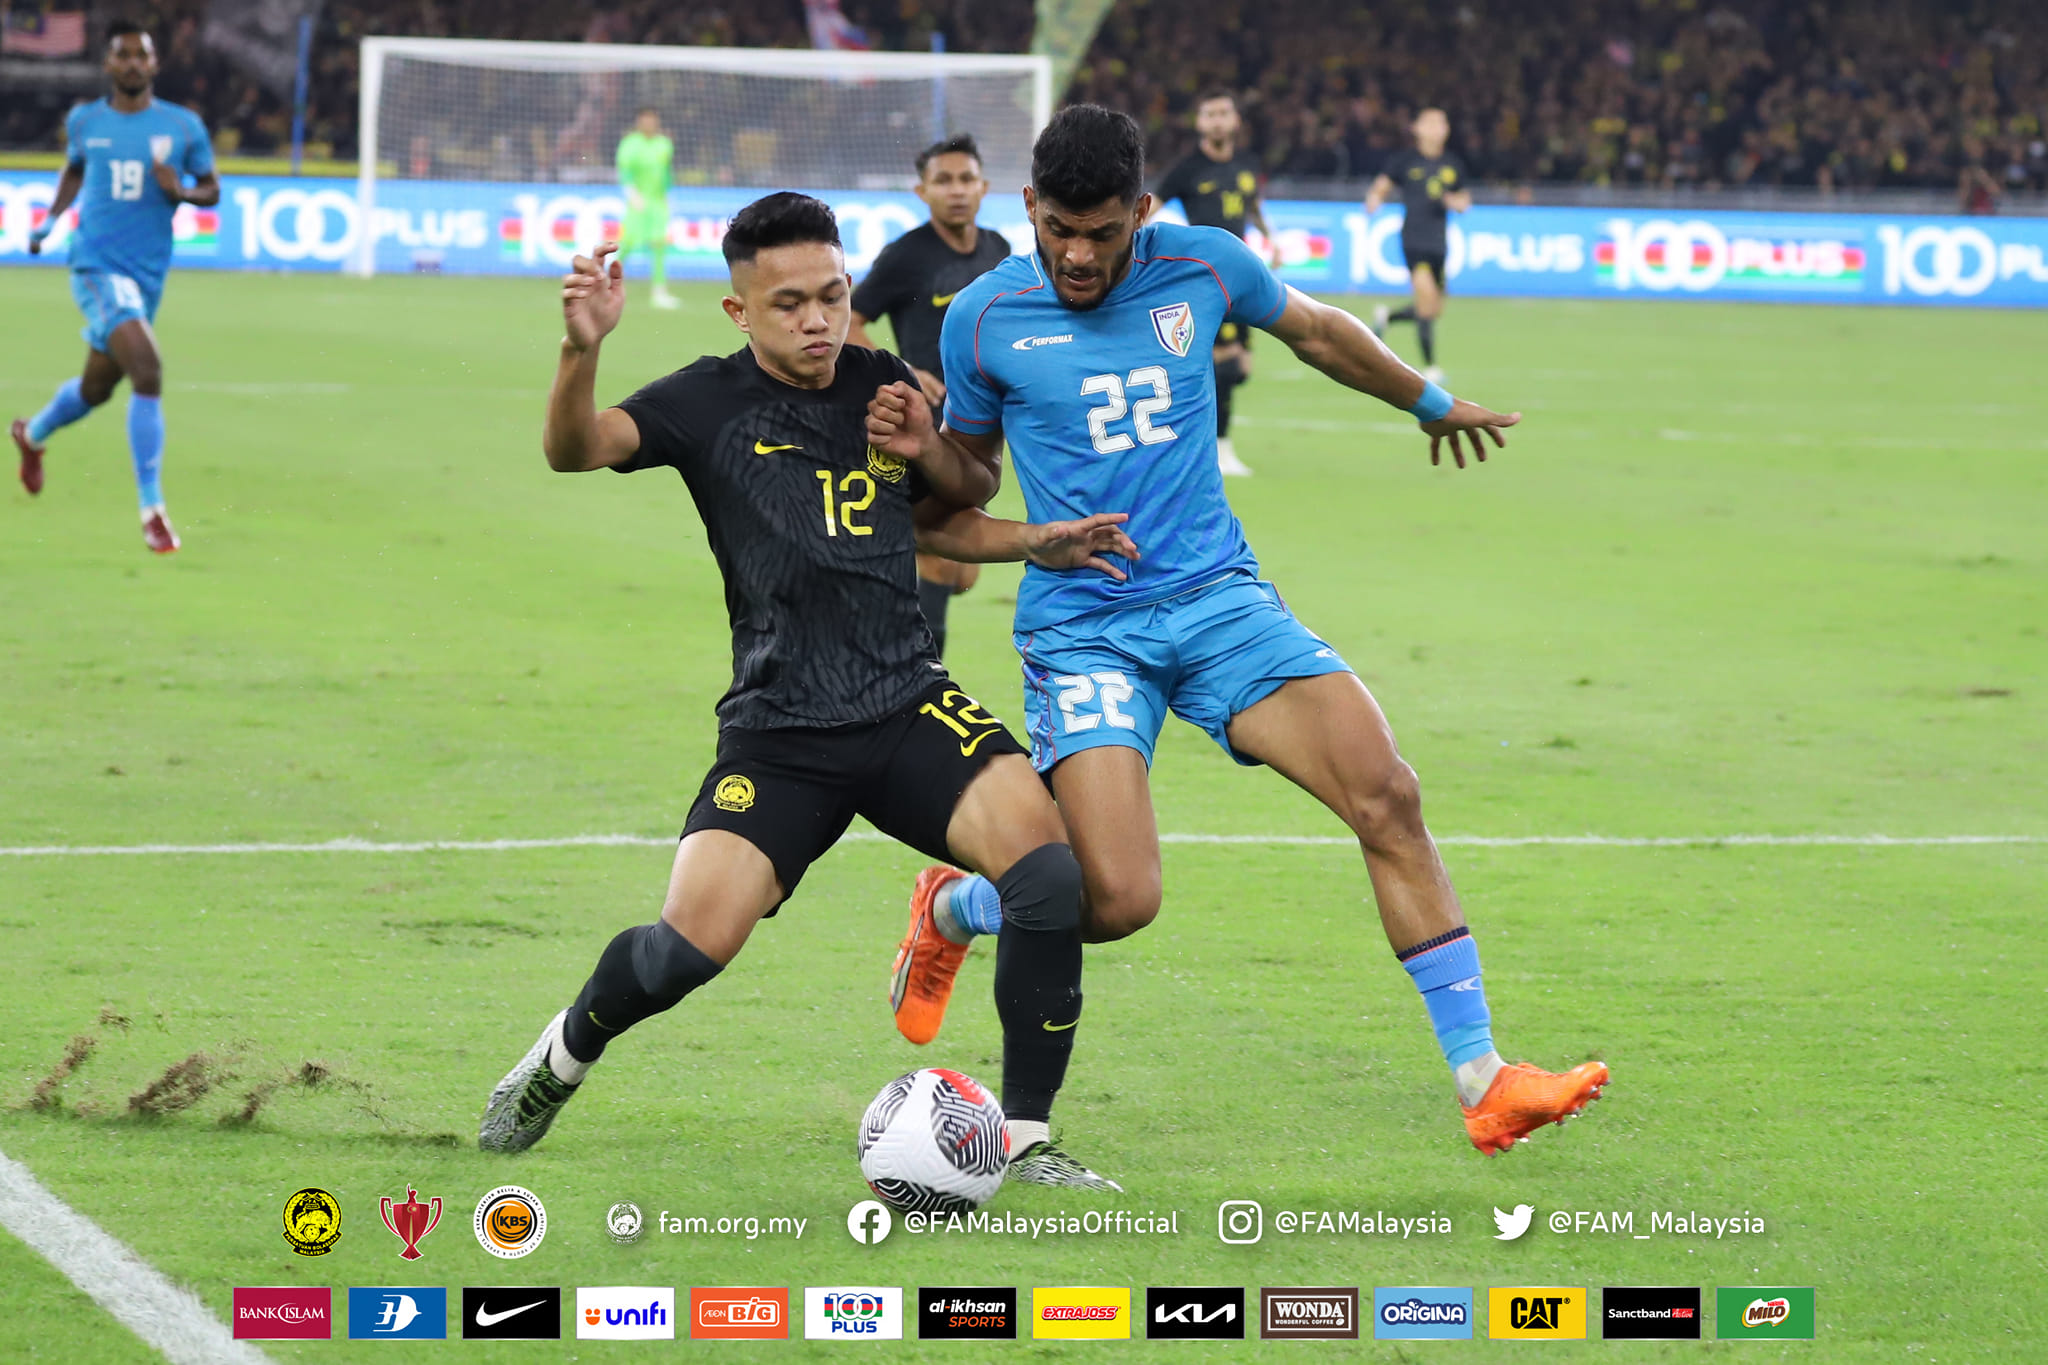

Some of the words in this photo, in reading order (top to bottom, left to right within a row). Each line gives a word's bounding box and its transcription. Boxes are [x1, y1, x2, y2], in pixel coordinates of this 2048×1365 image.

[109, 160, 144, 200] 19
[234, 187, 362, 261] 100
[367, 208, 487, 249] PLUS
[1469, 232, 1583, 273] PLUS
[1607, 218, 1728, 291] 100
[1730, 237, 1846, 277] PLUS
[1877, 224, 1996, 297] 100
[1032, 334, 1073, 347] PERFORMAX
[1159, 310, 1180, 321] INDIA
[1080, 365, 1178, 455] 22
[815, 469, 876, 537] 12
[919, 690, 1002, 738] 12
[1053, 671, 1135, 734] 22
